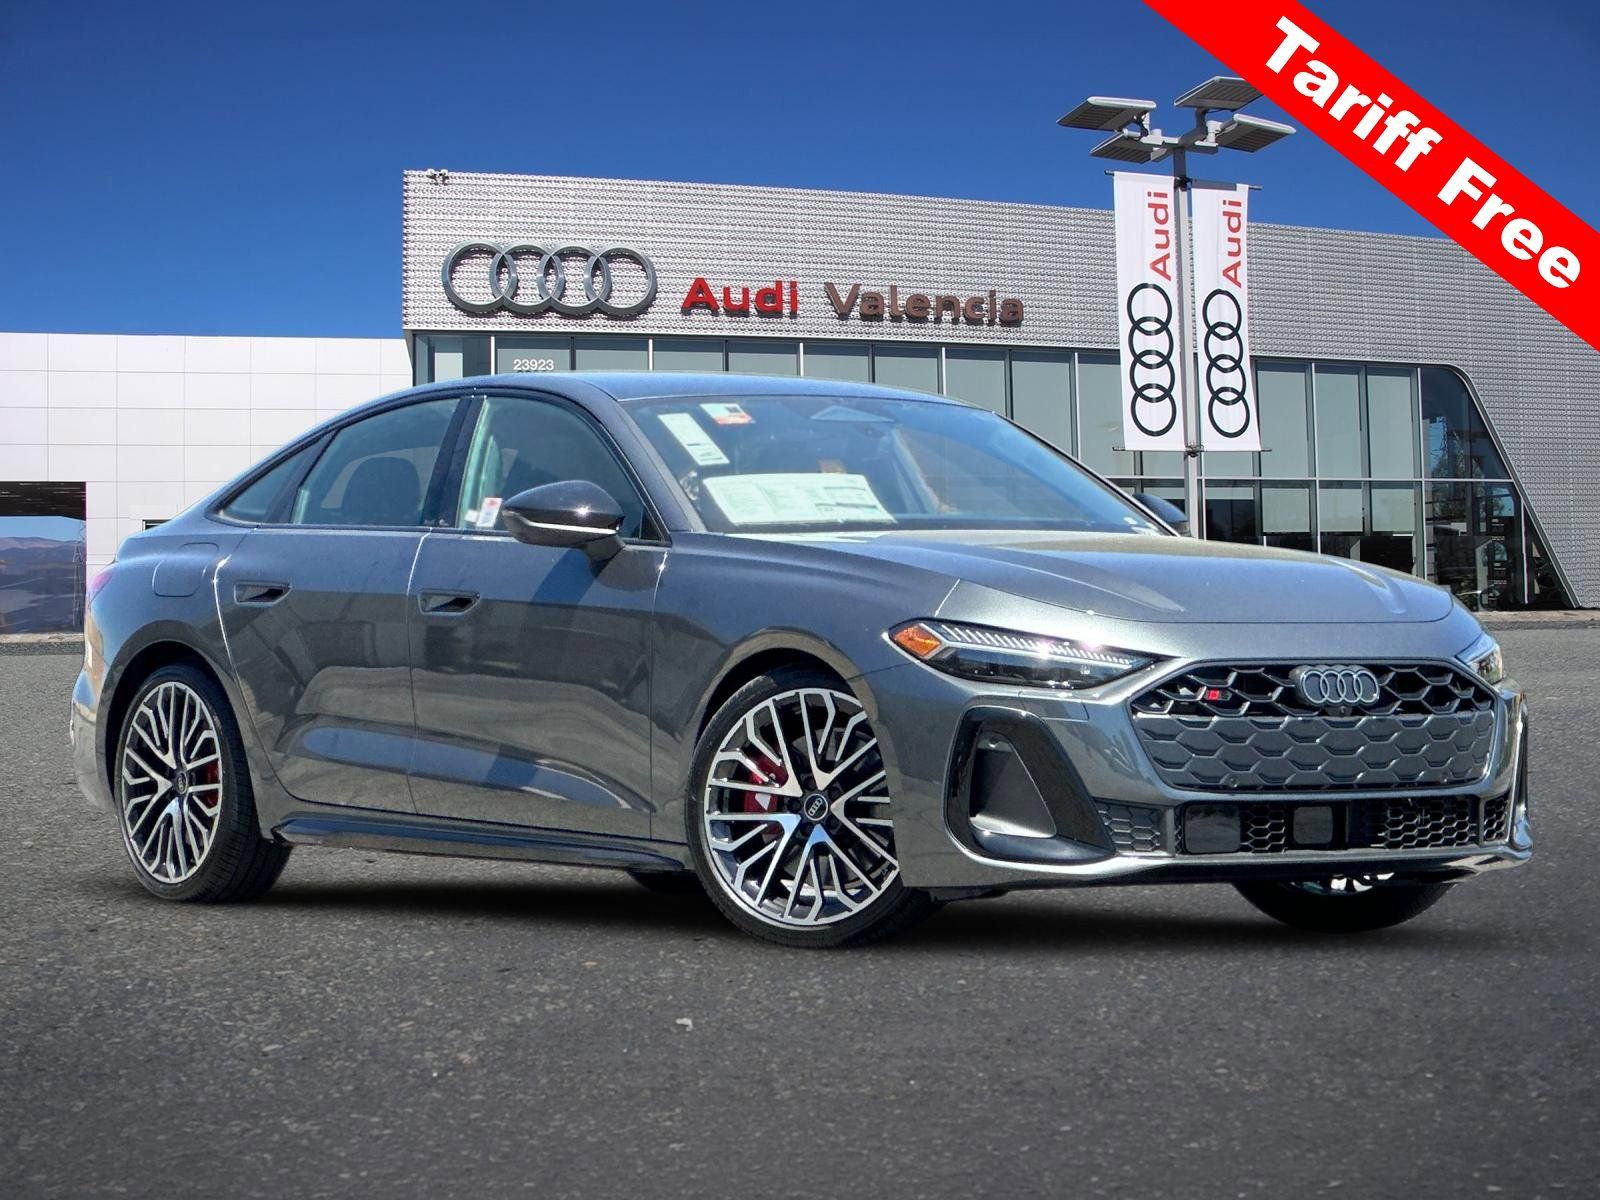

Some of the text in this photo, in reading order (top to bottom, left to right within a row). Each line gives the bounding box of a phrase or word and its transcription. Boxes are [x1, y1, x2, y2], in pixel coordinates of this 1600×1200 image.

[1147, 191, 1172, 282] Audi
[1222, 200, 1242, 289] Audi
[681, 276, 1024, 324] Audi Valencia
[513, 358, 555, 371] 23923
